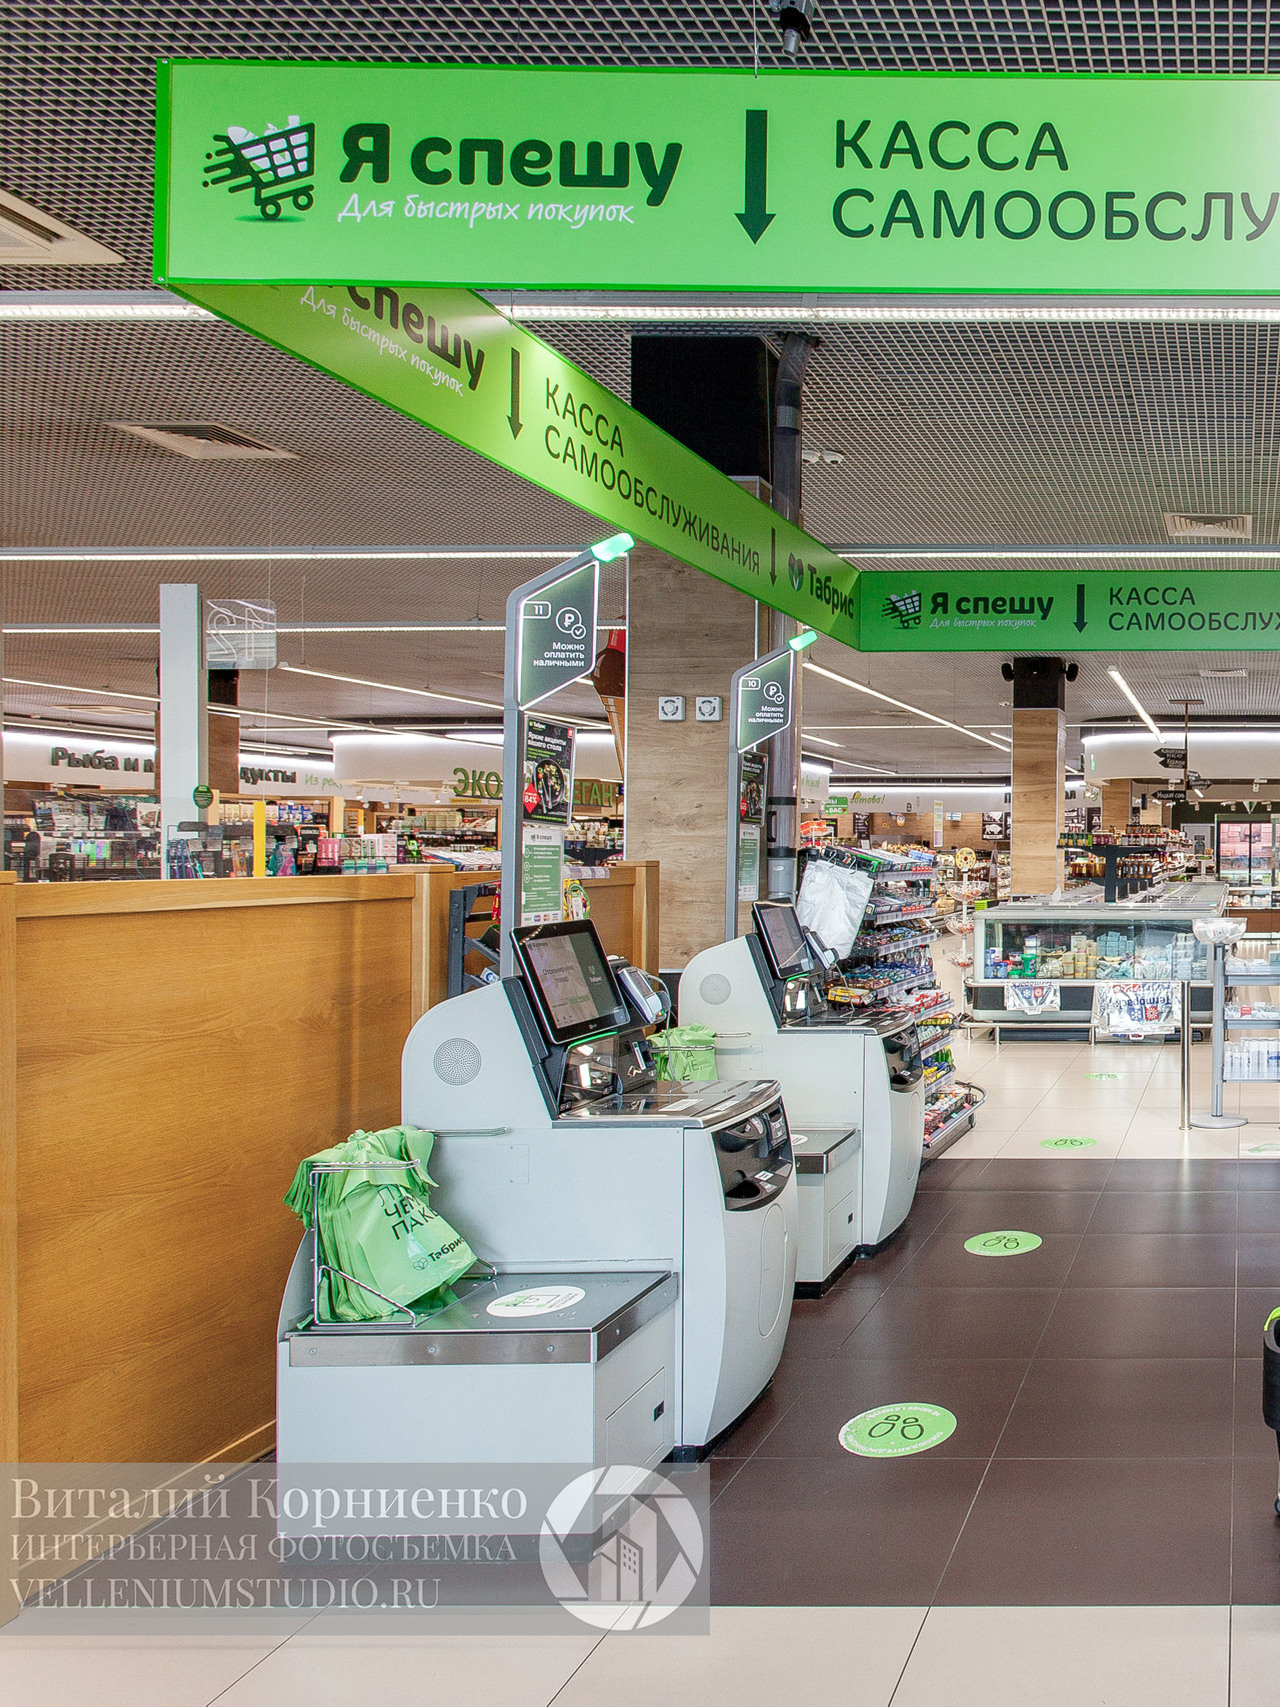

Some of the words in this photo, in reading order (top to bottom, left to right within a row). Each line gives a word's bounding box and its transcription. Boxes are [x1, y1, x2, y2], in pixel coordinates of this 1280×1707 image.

[835, 118, 1069, 171] КАССА
[338, 121, 391, 184] Я
[411, 138, 683, 208] спешу
[337, 194, 396, 224] Для
[404, 194, 520, 230] быстрых
[527, 201, 635, 229] покупок
[300, 286, 337, 319] Для
[341, 307, 408, 362] быстрых
[410, 352, 464, 398] покупок
[545, 376, 625, 459] КАССА
[543, 426, 761, 575] САМООБСЛУЖИВАНИЯ
[807, 562, 856, 622] Табрис
[930, 591, 949, 615] Я
[955, 593, 1055, 622] спешу
[1108, 586, 1197, 606] КАССА
[534, 605, 543, 615] 11
[930, 616, 951, 629] Для
[954, 615, 996, 631] быстрых
[998, 618, 1037, 631] покупок
[544, 651, 585, 659] оплатить
[552, 641, 585, 650] Можно
[747, 680, 757, 688] 10
[51, 746, 120, 771] Рыба
[124, 756, 140, 772] и
[453, 767, 501, 798] ЭКО
[524, 795, 537, 804] 84%
